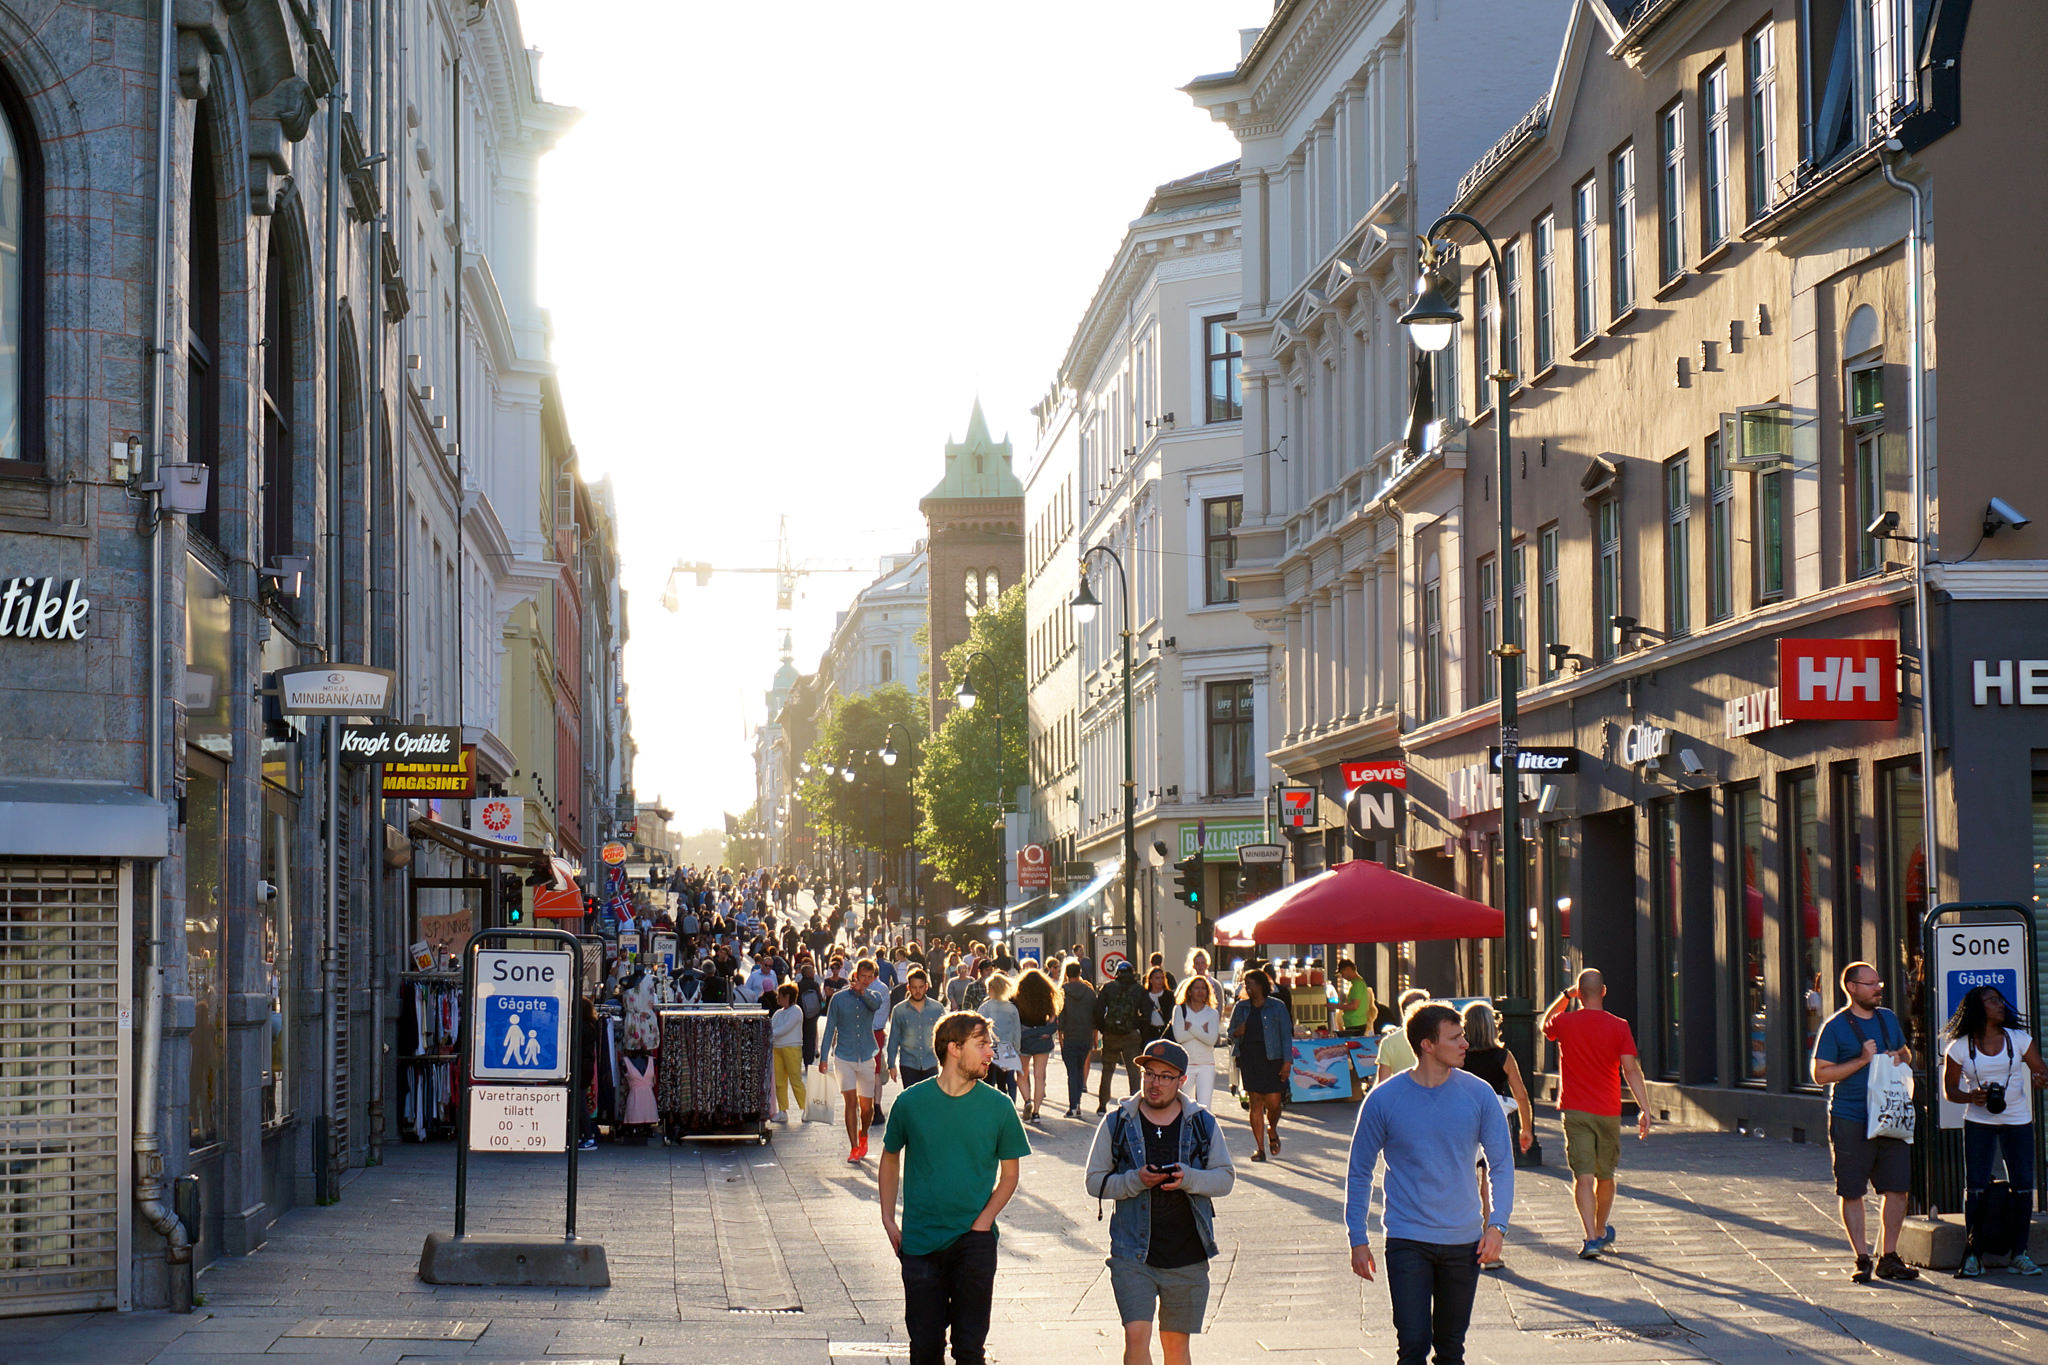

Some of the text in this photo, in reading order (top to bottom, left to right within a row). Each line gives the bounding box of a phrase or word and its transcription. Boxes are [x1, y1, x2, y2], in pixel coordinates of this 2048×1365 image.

[1973, 659, 2048, 705] HE
[292, 692, 381, 706] MINIBANK/ATM
[340, 730, 451, 757] Krogh Optikk
[1624, 720, 1666, 765] Glitter
[382, 776, 470, 790] MAGASINET
[1285, 792, 1312, 827] 7
[1360, 792, 1395, 830] N
[1185, 828, 1272, 852] BKLAGERE
[603, 851, 625, 861] KING
[1245, 850, 1281, 858] MINIBANK
[657, 942, 673, 950] Sone
[1019, 936, 1039, 944] Sone
[1102, 937, 1127, 947] Sone
[1952, 933, 2010, 956] Sone
[493, 959, 555, 982] Sone
[1958, 972, 2006, 987] Gågate
[498, 997, 547, 1013] Gågate
[479, 1090, 561, 1103] Varetransport
[504, 1105, 535, 1116] tillatt
[498, 1121, 513, 1131] 00
[531, 1121, 539, 1131] 11
[489, 1136, 509, 1147] (00
[527, 1136, 547, 1147] 09)
